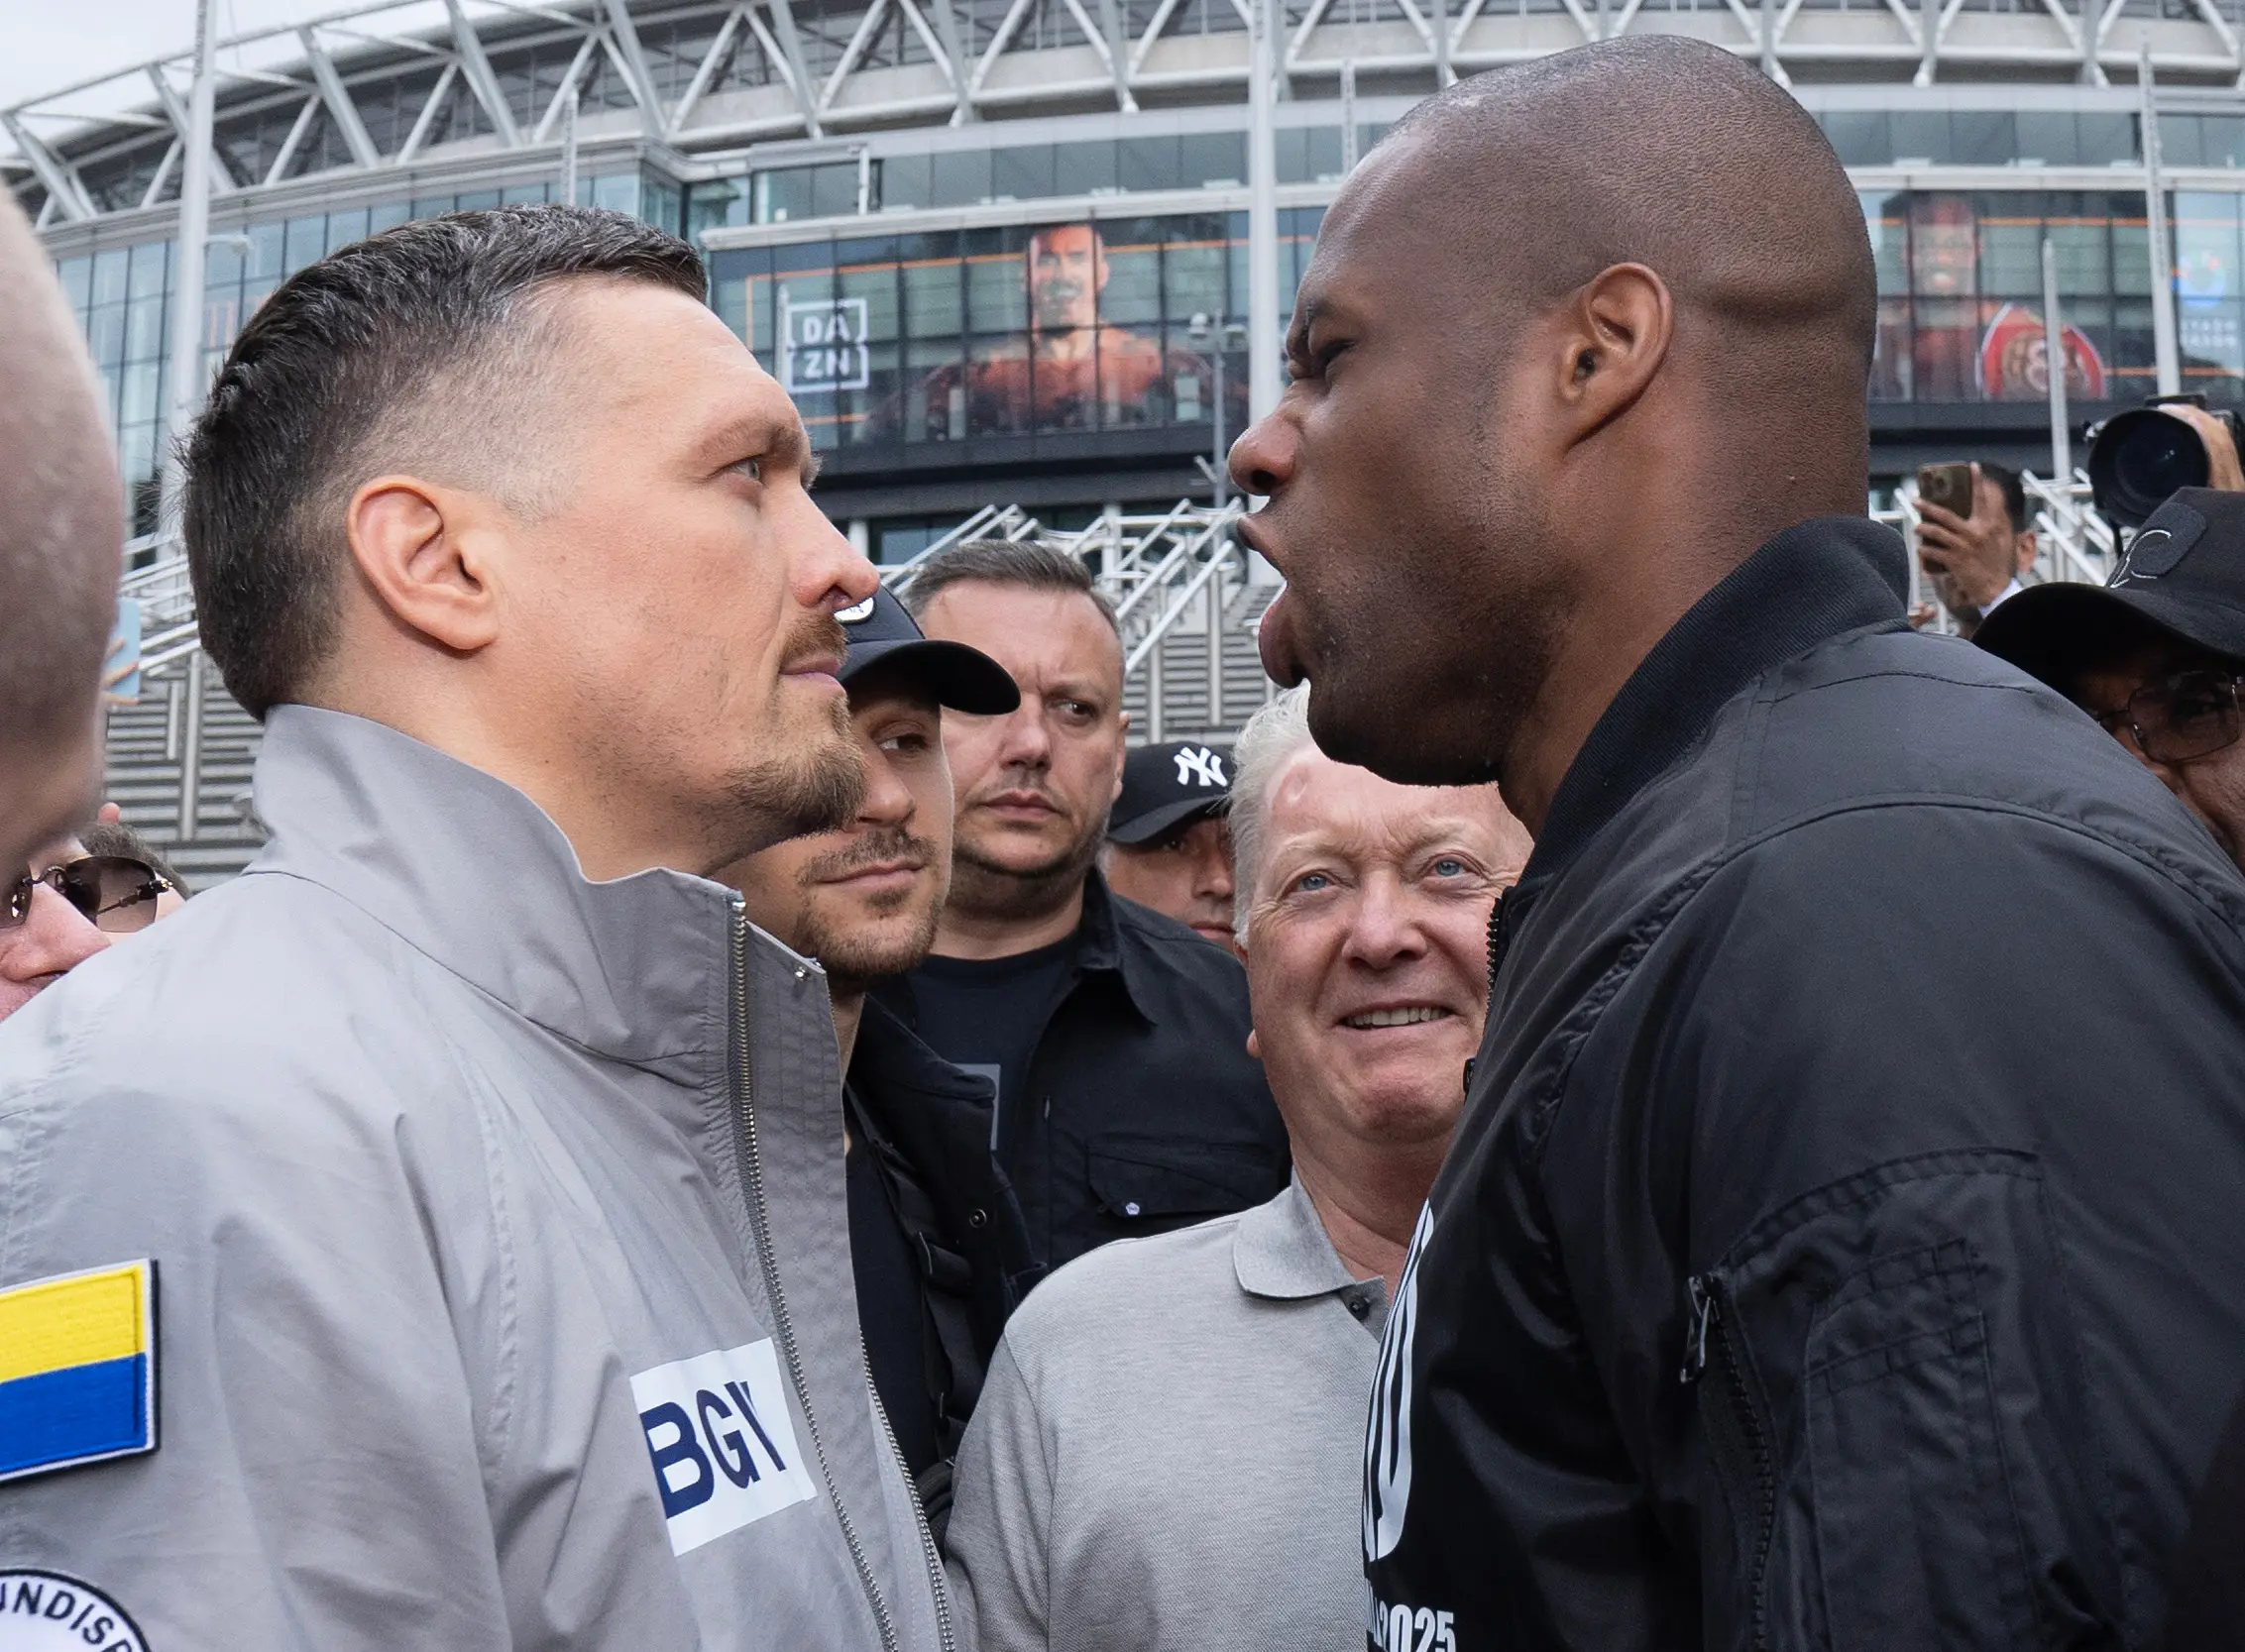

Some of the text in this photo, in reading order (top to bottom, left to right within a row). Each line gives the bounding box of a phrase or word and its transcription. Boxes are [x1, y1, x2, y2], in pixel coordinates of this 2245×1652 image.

[803, 313, 850, 344] DA
[803, 348, 850, 379] ZN
[1174, 746, 1228, 787] NY
[1379, 1599, 1456, 1652] 2025
